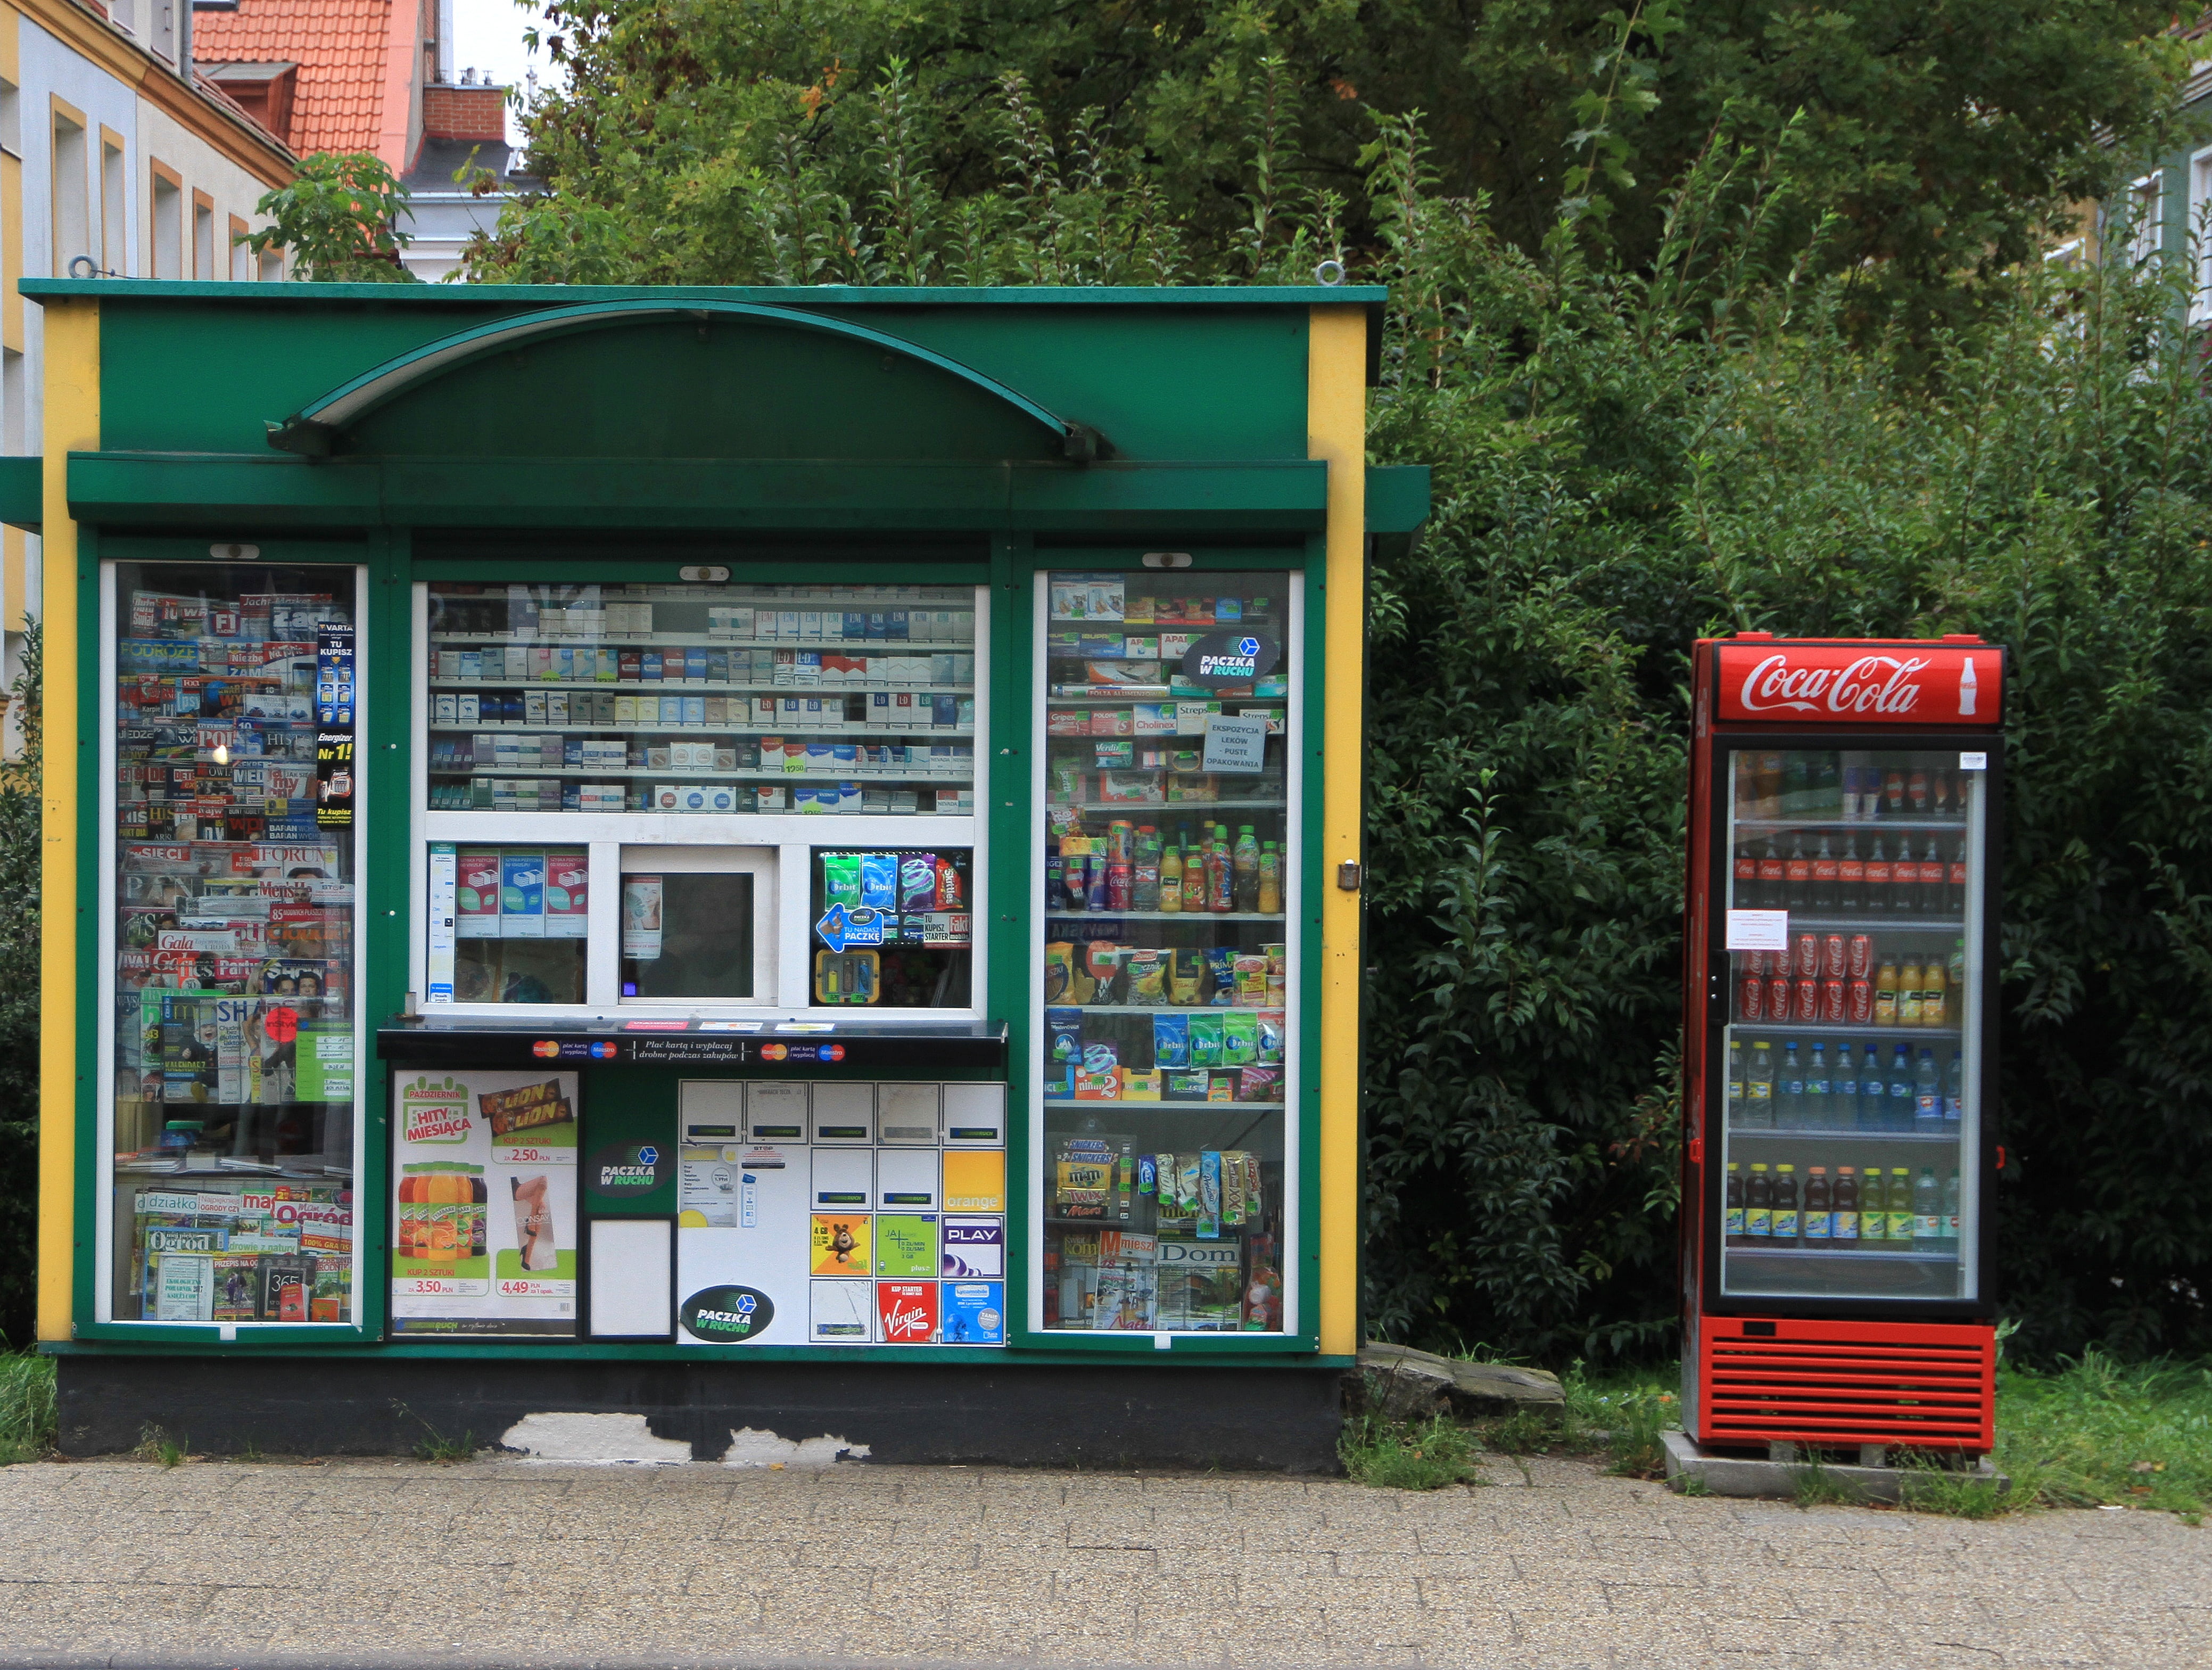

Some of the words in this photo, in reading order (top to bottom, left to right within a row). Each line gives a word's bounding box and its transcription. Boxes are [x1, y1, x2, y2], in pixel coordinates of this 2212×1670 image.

[215, 613, 236, 630] F1
[1200, 655, 1255, 667] PACZKA
[1200, 665, 1214, 674] W
[1213, 666, 1255, 677] RUCHU
[1740, 654, 1933, 713] Coca-Cola
[1051, 713, 1076, 722] Gripex
[1136, 720, 1175, 729] Cholinex
[1212, 724, 1259, 734] EKSPOZYCJA
[318, 733, 353, 743] Energizer
[1221, 735, 1248, 744] LEKÓW
[318, 748, 334, 760] Nr
[335, 743, 353, 760] 1!
[1206, 758, 1259, 768] OPAKOWANIA
[833, 883, 856, 892] Orbit
[871, 883, 894, 892] Orbit
[944, 868, 954, 904] Skittles
[272, 909, 284, 920] 85
[950, 916, 969, 932] Fakt
[161, 935, 193, 950] Gala
[844, 932, 880, 942] PACZKĘ
[219, 960, 259, 976] Party
[666, 1041, 688, 1050] kartą
[639, 1050, 666, 1059] drobne
[667, 1051, 701, 1061] podczas
[703, 1051, 739, 1061] zakupów
[1101, 1075, 1118, 1098] 2
[409, 1090, 461, 1098] PAŹDZIERNIK
[506, 1084, 546, 1108] LION
[417, 1107, 449, 1125] HITY
[515, 1101, 557, 1127] LION
[407, 1118, 473, 1141] MIESIĄCA
[1069, 1139, 1105, 1150] SNICKERS
[511, 1149, 539, 1162] 2,50
[1071, 1152, 1112, 1163] SNICKERS
[601, 1166, 655, 1176] PACZKA
[600, 1175, 614, 1185] W
[614, 1175, 655, 1185] RUCHU
[1202, 1173, 1215, 1203] Princessa
[149, 1196, 197, 1211] działko
[947, 1196, 998, 1210] orange
[431, 1206, 456, 1222] TYMBARK
[1067, 1205, 1103, 1217] Mars
[948, 1229, 997, 1240] PLAY
[267, 1245, 296, 1254] natury
[1160, 1245, 1237, 1262] Dom
[416, 1280, 441, 1294] 3,50
[501, 1281, 529, 1294] 4,49
[697, 1309, 752, 1325] PACZKA
[884, 1299, 927, 1337] Virgin
[696, 1318, 708, 1328] W
[708, 1320, 751, 1334] RUCHU
